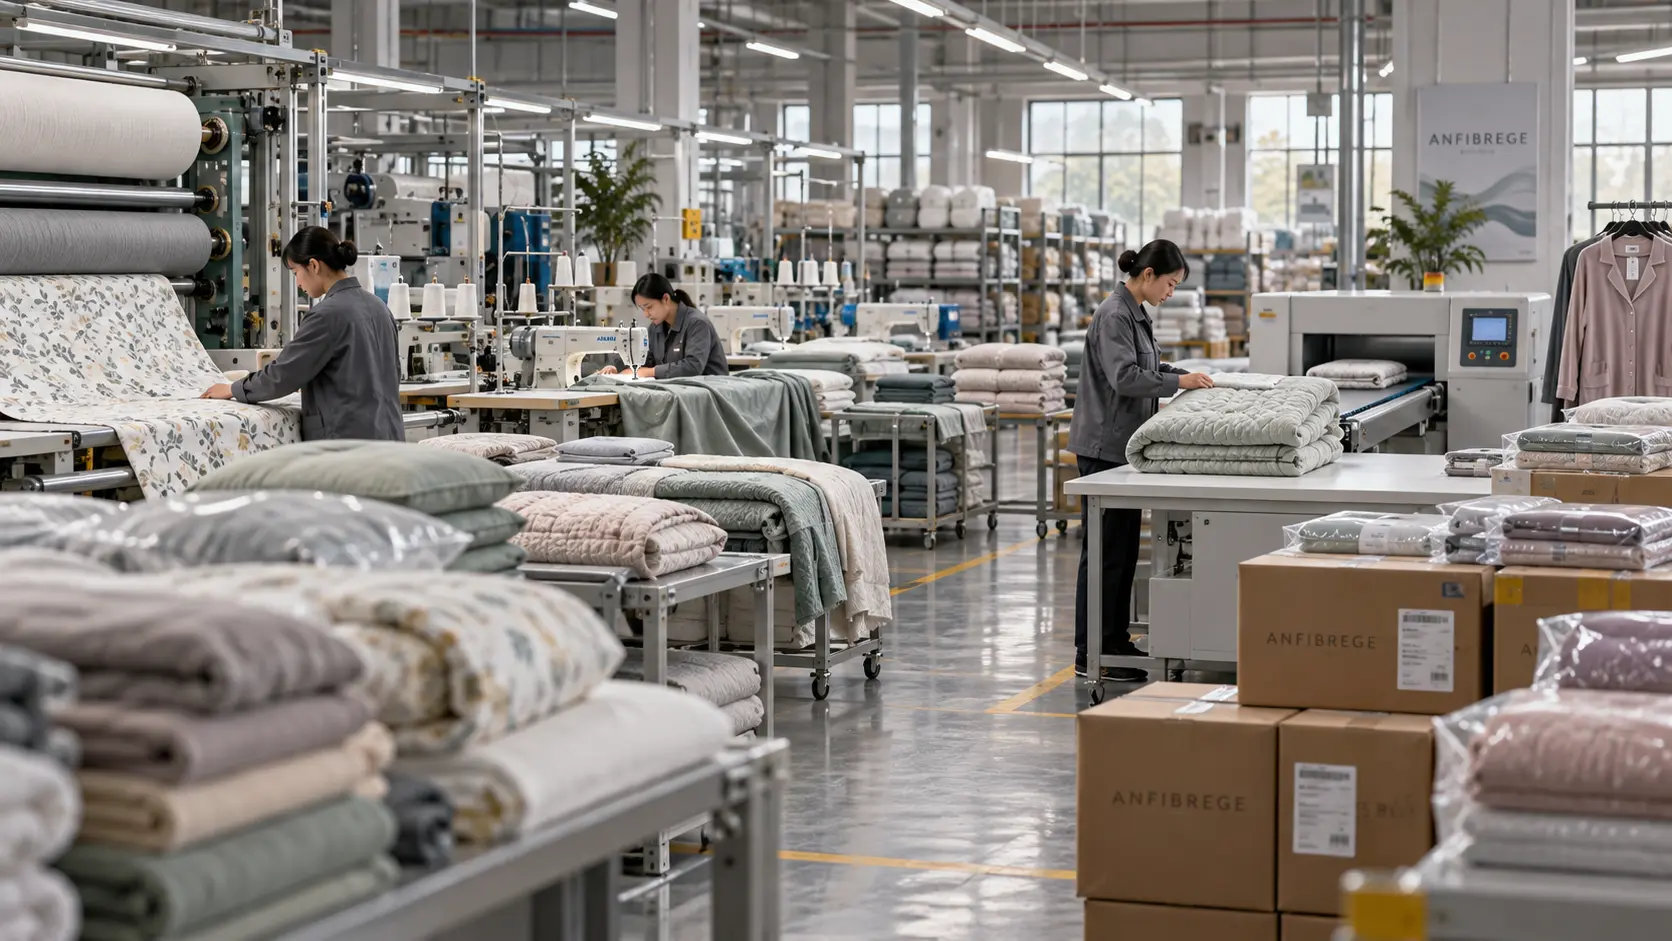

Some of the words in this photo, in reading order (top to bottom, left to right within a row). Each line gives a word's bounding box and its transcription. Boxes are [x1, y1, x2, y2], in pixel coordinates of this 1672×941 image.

[1429, 132, 1528, 145] ANFIBREGE
[1266, 632, 1376, 649] ANFIBREGE
[1521, 643, 1538, 657] A
[1112, 791, 1246, 812] ANFIBREGE
